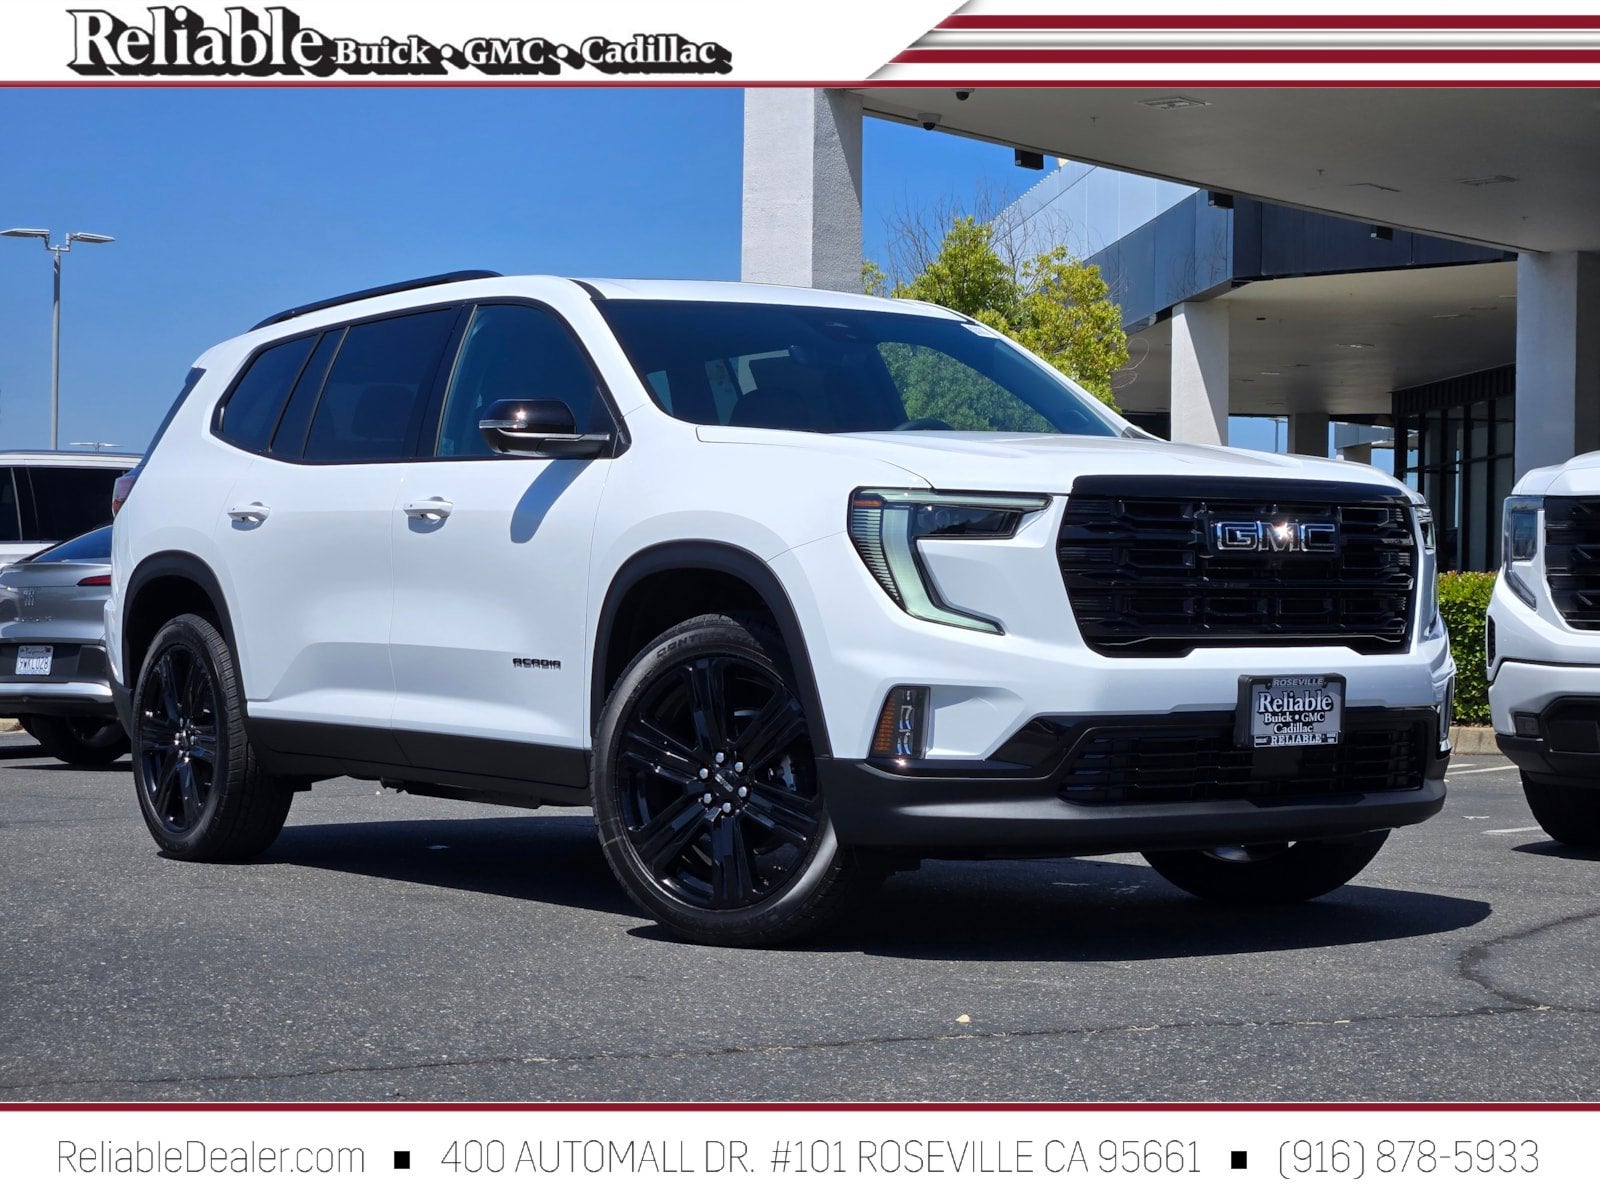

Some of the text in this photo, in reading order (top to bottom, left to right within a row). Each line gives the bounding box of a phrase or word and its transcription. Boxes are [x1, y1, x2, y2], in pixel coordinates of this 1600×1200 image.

[1216, 520, 1336, 552] GMC
[512, 657, 562, 669] ACADIA
[1273, 679, 1325, 687] ROSEVILLE
[1258, 689, 1334, 714] Reliable
[1264, 711, 1326, 724] Buick GMC
[1273, 722, 1314, 735] Cadillac
[1271, 733, 1322, 746] RELIABLE
